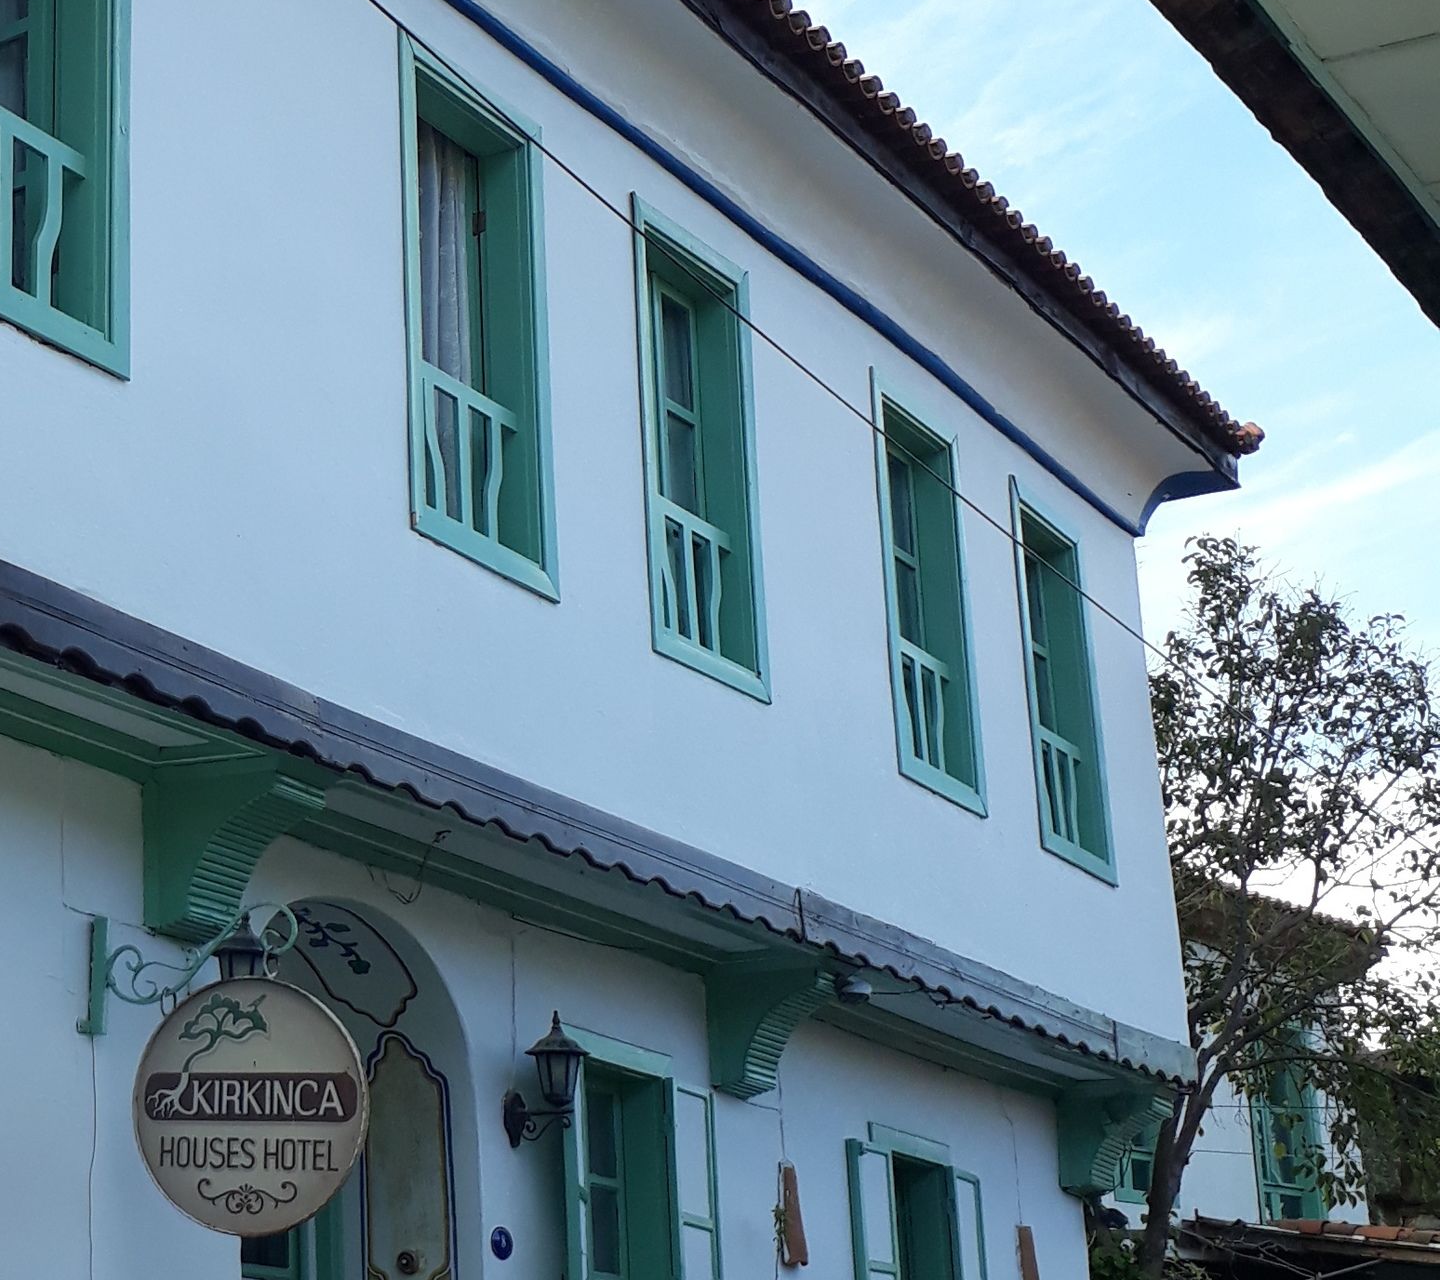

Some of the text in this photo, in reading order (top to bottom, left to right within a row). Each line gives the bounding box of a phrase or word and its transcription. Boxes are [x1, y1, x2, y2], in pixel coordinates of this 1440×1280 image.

[190, 1080, 343, 1116] KIRKINCA
[160, 1136, 339, 1171] HOUSES HOTEL
